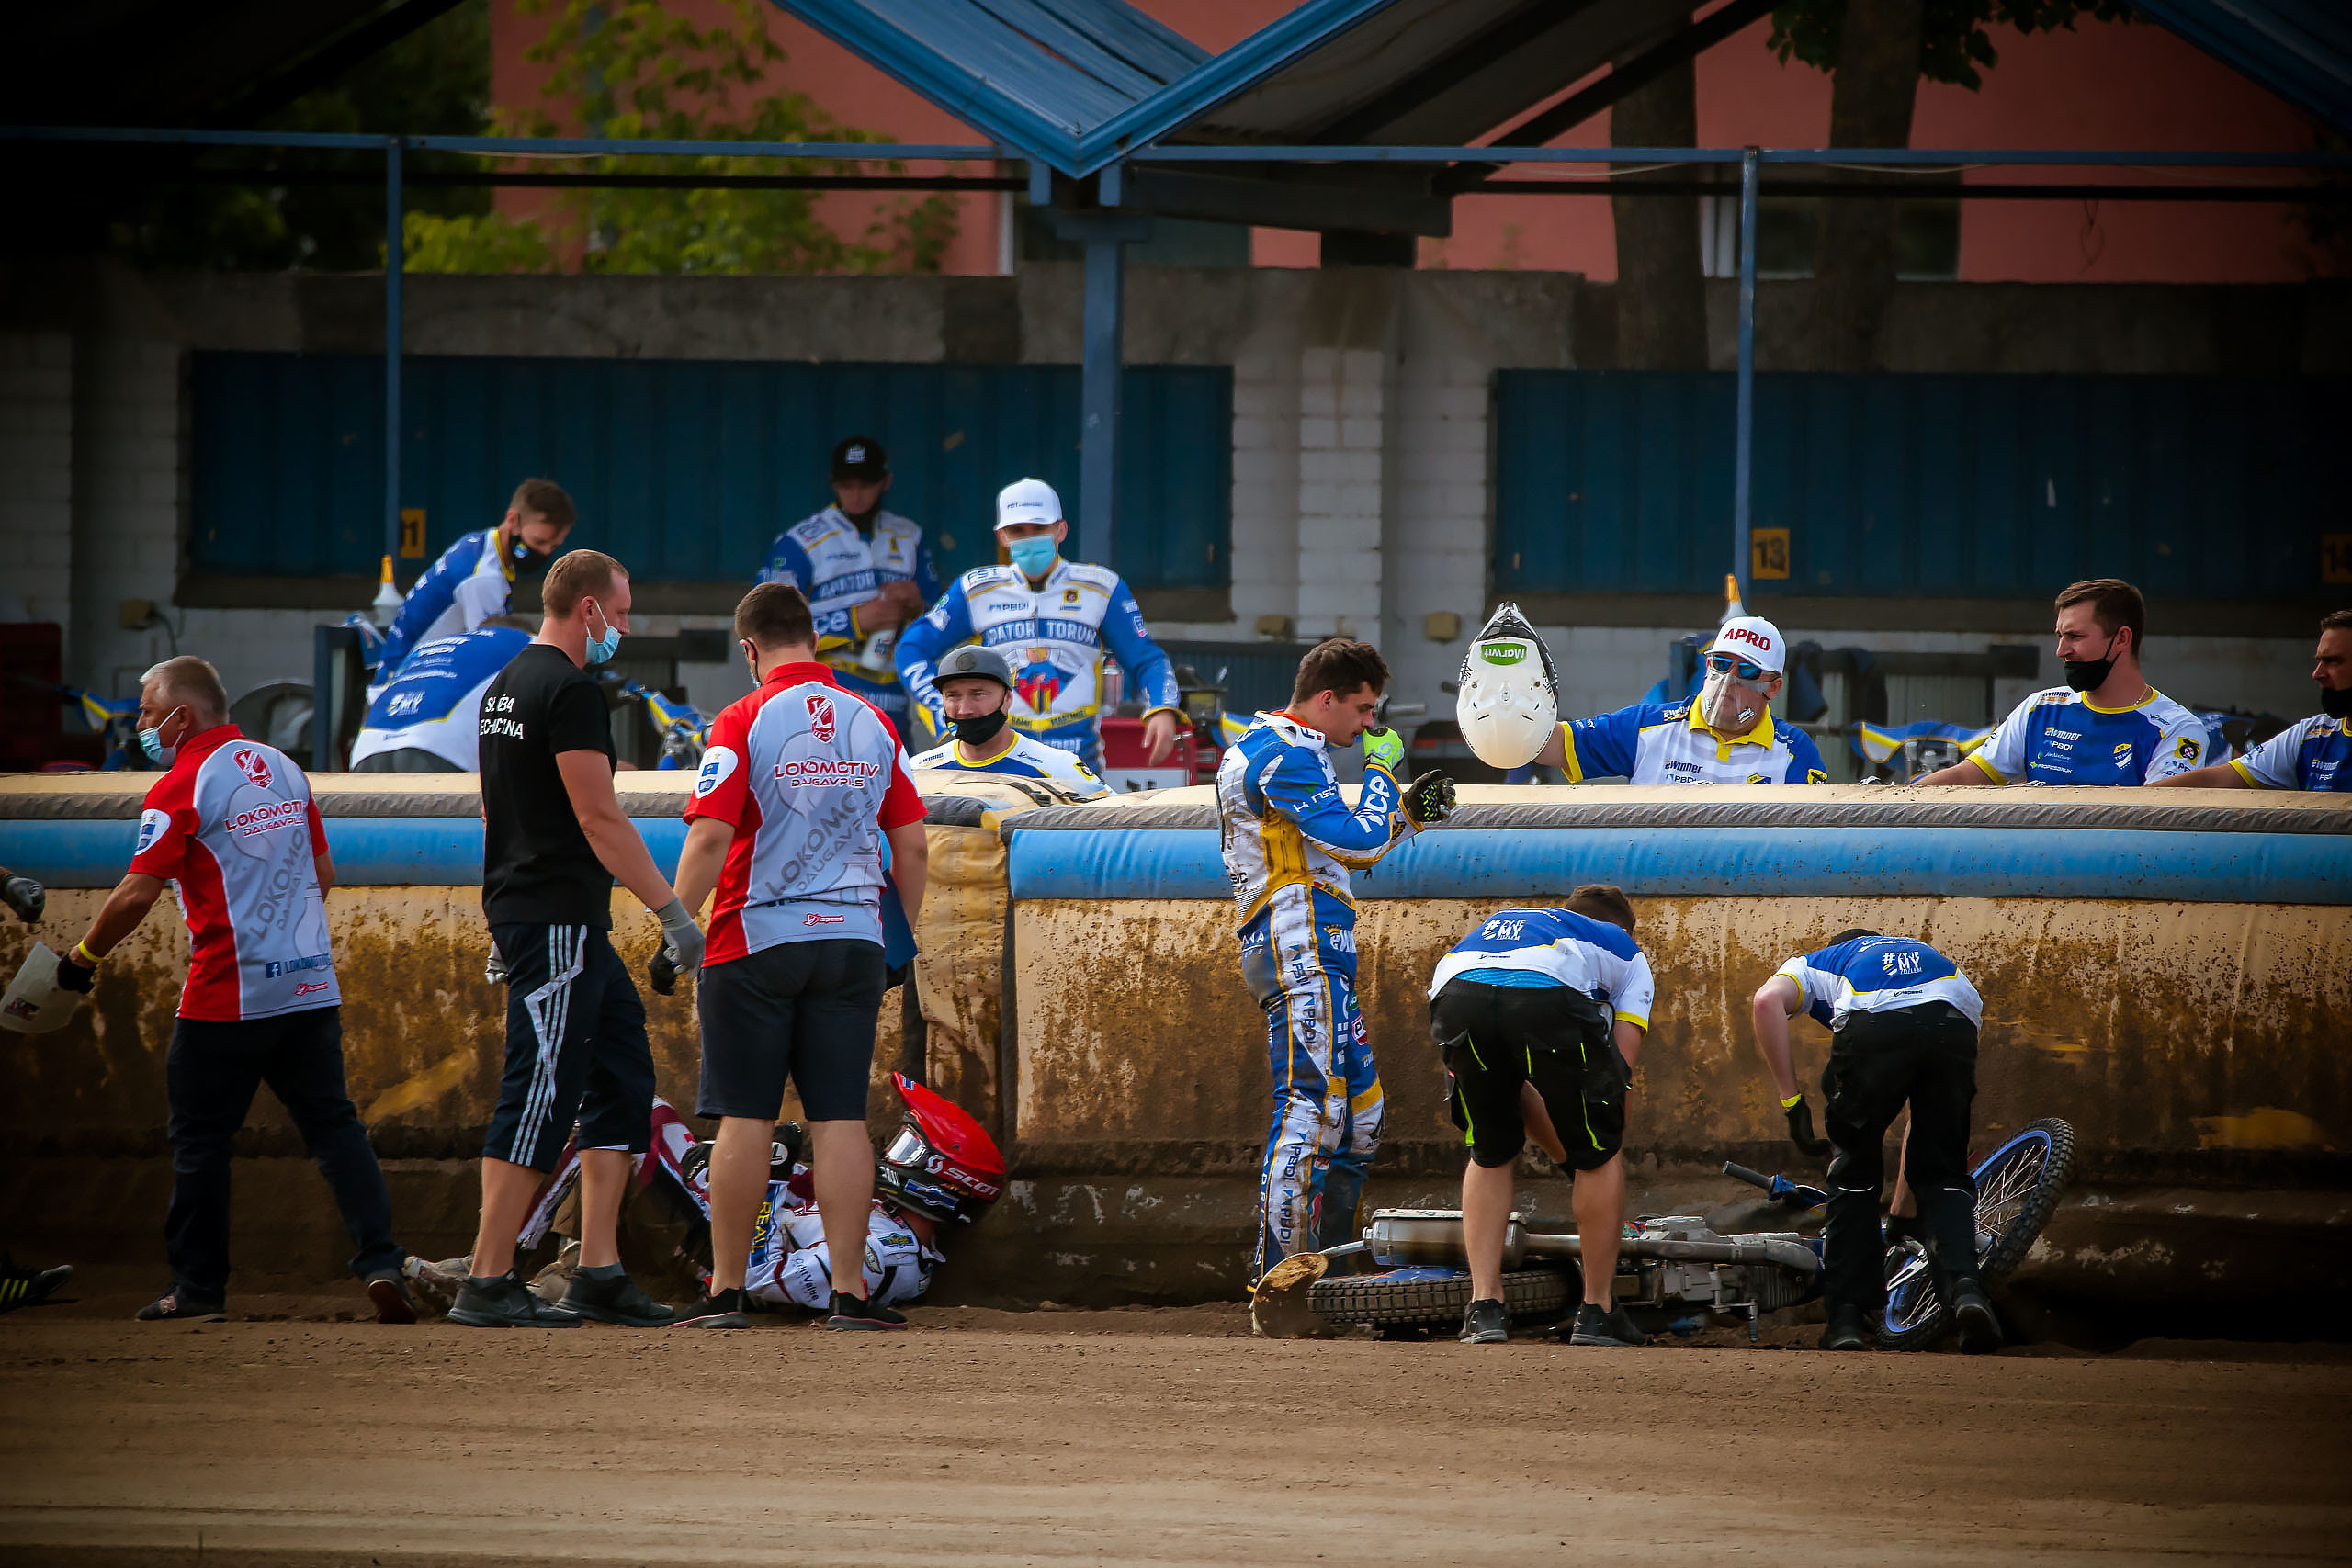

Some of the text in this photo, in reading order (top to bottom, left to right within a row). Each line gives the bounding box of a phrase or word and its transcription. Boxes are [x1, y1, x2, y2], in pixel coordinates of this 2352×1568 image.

[1724, 628, 1771, 651] APRO
[1484, 648, 1525, 659] Marwit
[2052, 740, 2074, 750] PBDI
[775, 761, 879, 778] LOKOMOTIV
[1283, 1146, 1302, 1181] PBDI
